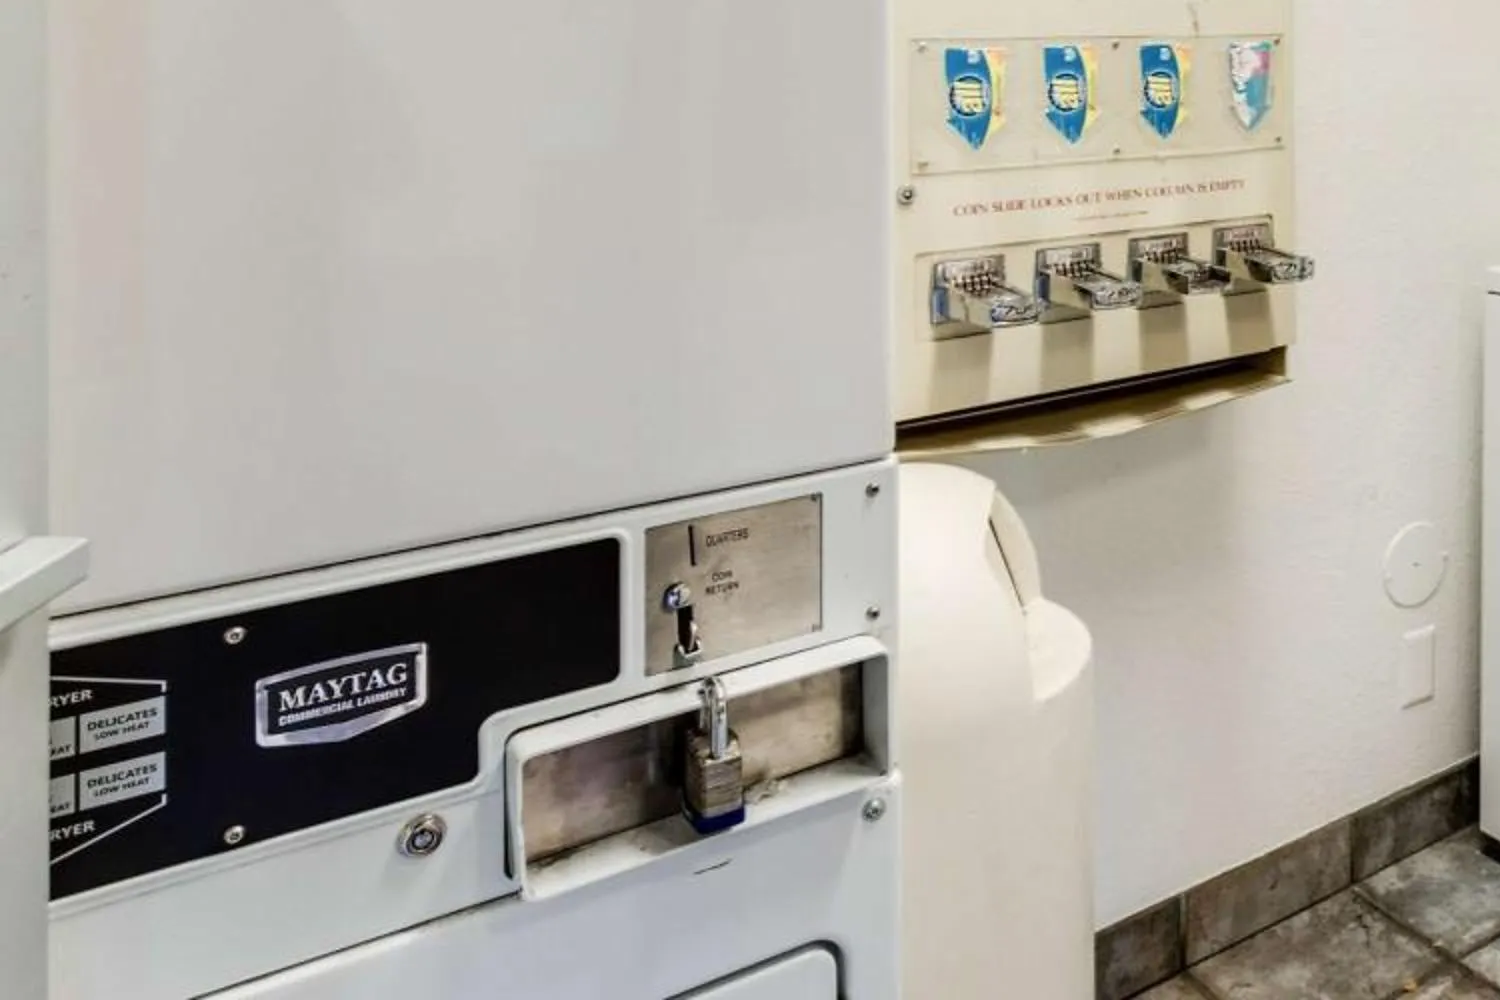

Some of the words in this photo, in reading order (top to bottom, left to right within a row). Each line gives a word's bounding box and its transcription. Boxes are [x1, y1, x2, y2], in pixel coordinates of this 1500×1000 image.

[278, 662, 408, 713] MAYTAG
[49, 689, 93, 708] RYER
[278, 699, 356, 727] COMMERCIAL
[356, 686, 408, 707] LAUNDRY
[87, 707, 158, 731] DELICATES
[94, 729, 119, 742] LOW
[122, 721, 150, 735] HEAT
[50, 744, 72, 758] EAT
[87, 763, 158, 789] DELICATES
[94, 785, 119, 798] LOW
[122, 777, 150, 791] HEAT
[50, 801, 70, 813] EAT
[49, 820, 96, 841] RYER
